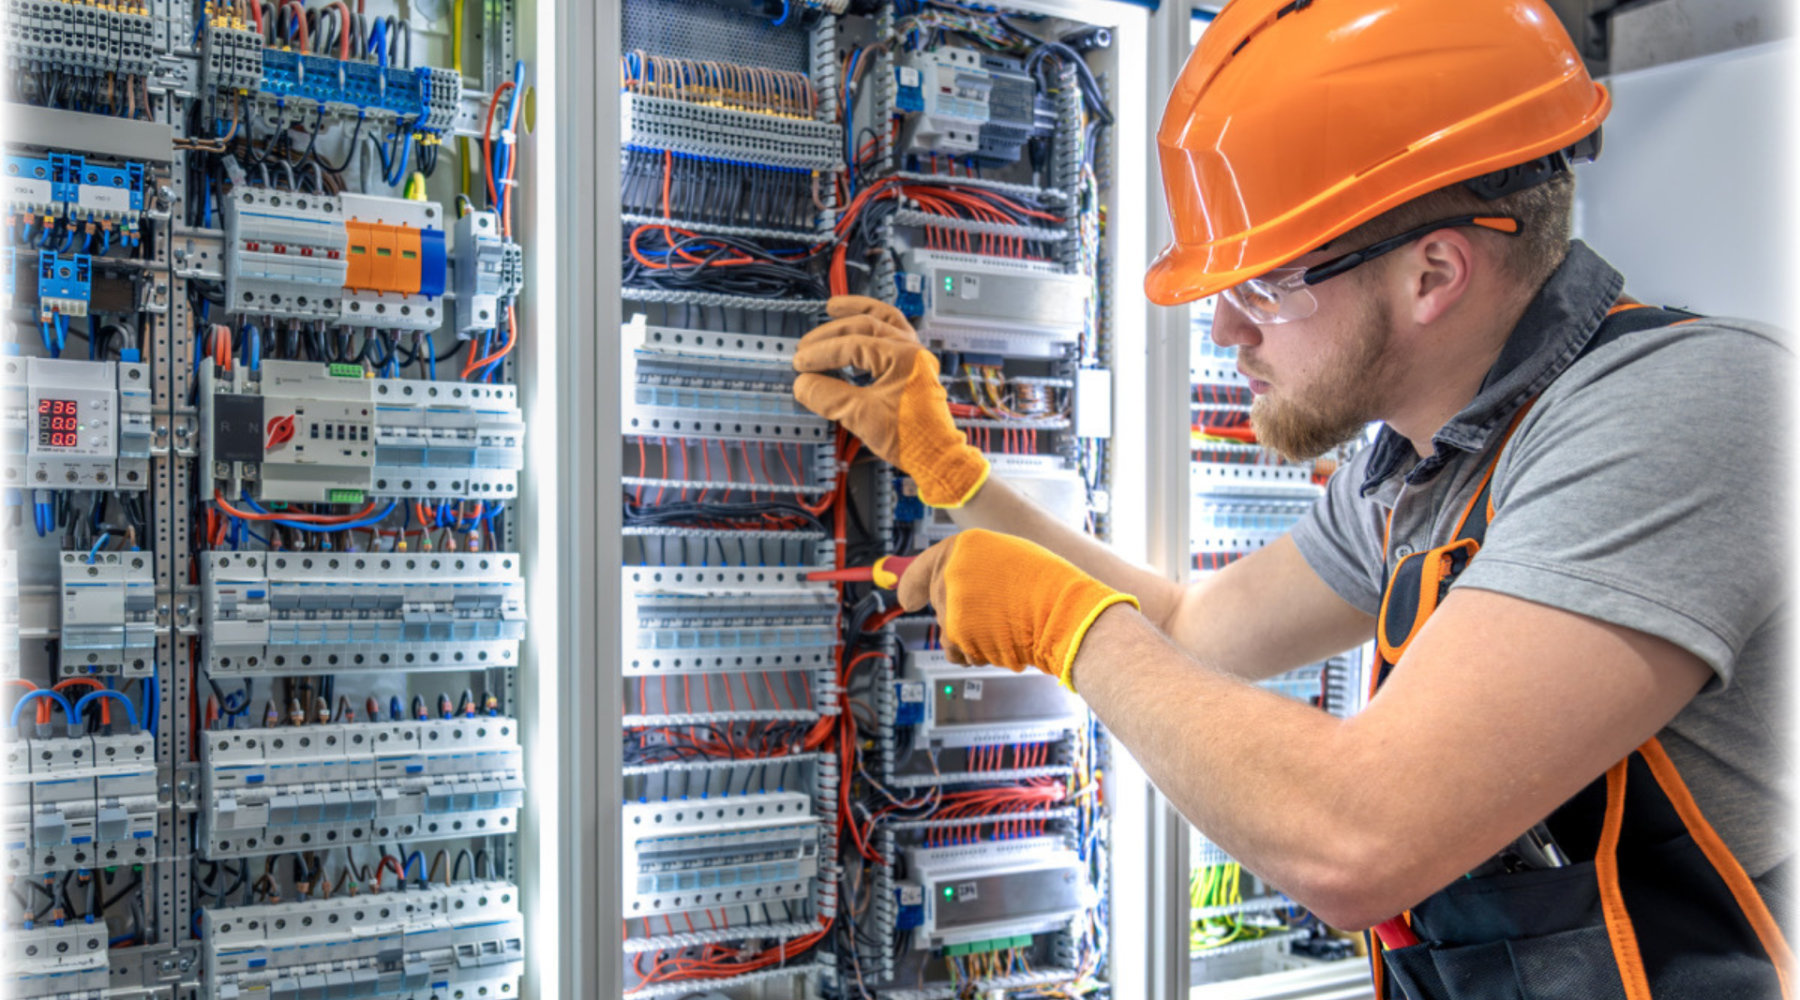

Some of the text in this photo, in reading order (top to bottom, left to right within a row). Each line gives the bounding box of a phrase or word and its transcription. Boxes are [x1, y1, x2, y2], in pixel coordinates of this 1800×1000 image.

[38, 400, 77, 415] 236
[51, 416, 77, 431] 0.0
[220, 421, 259, 434] R N
[51, 433, 77, 447] 0.0
